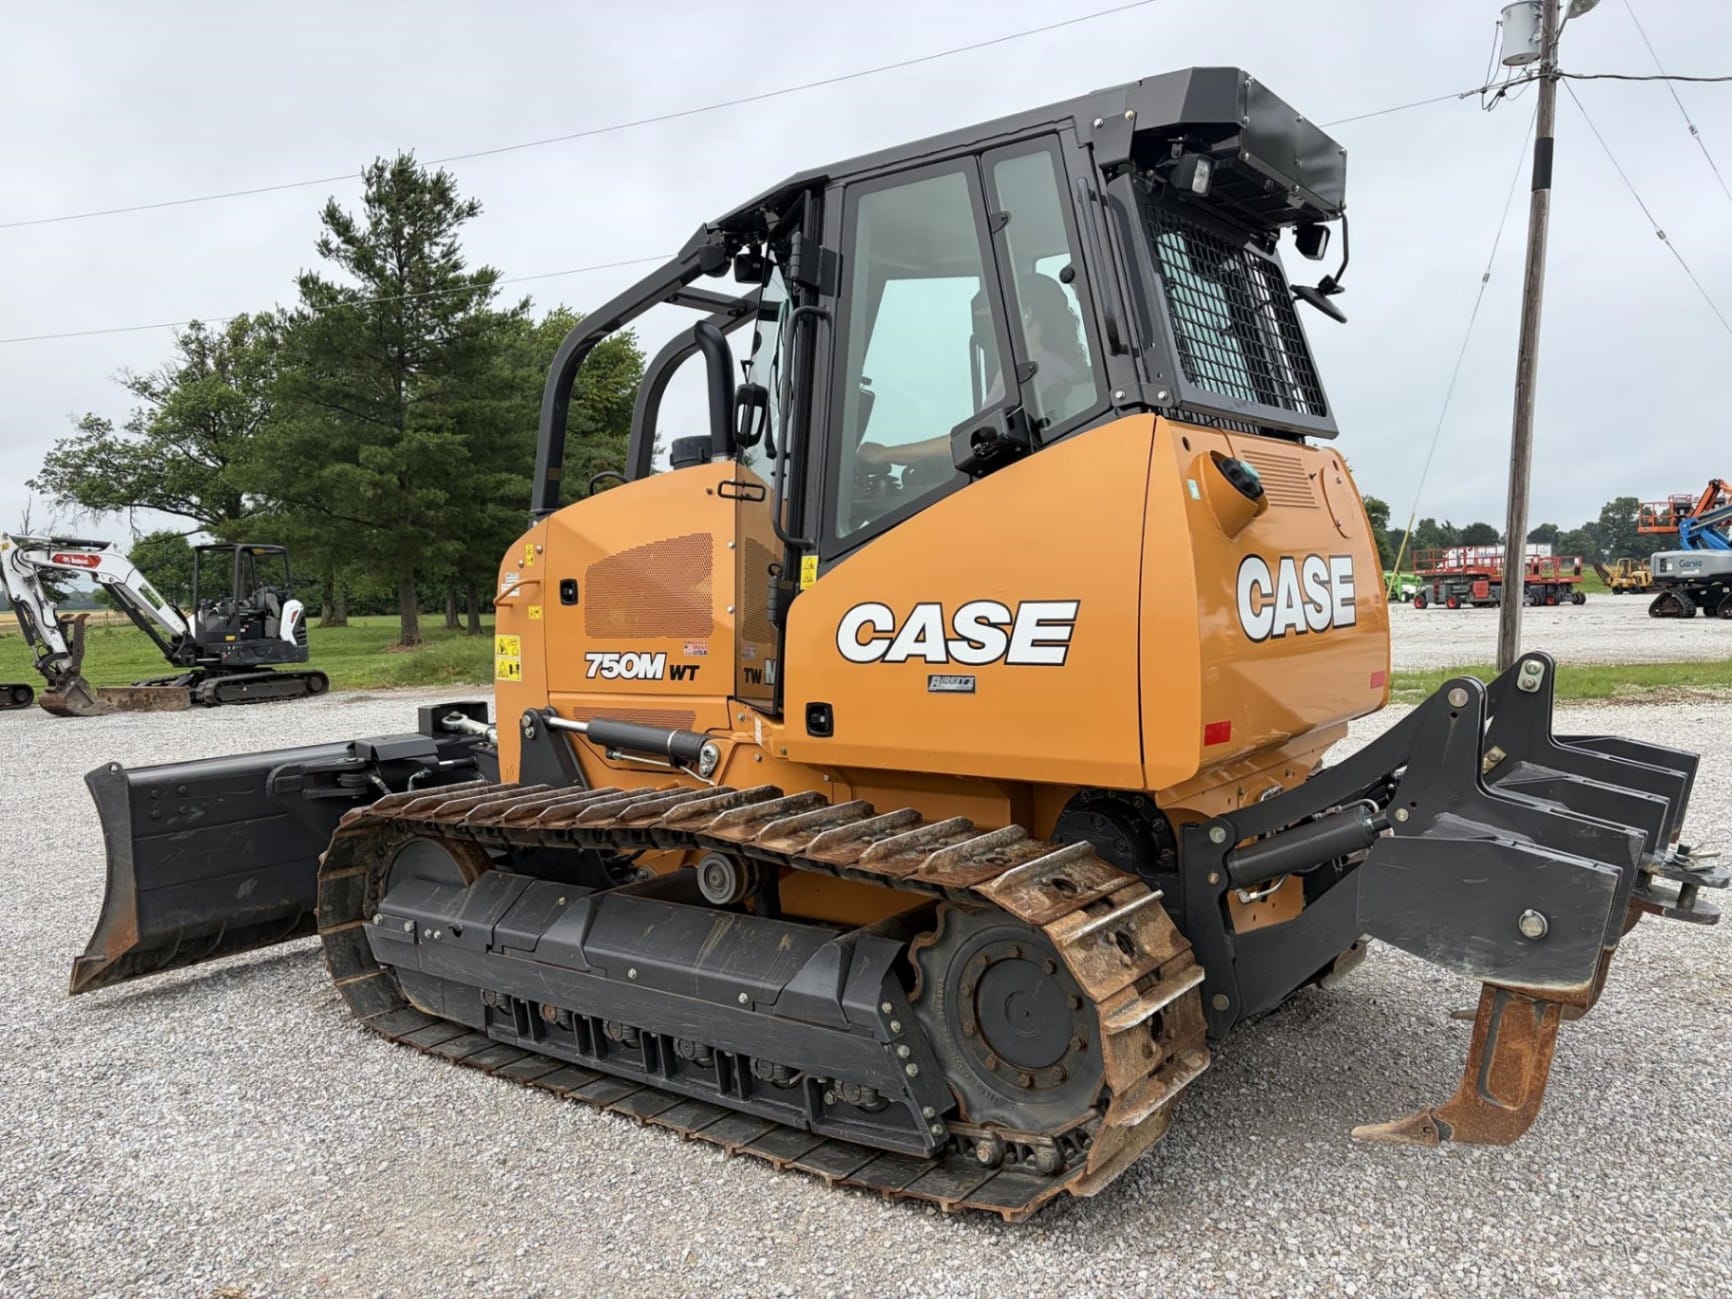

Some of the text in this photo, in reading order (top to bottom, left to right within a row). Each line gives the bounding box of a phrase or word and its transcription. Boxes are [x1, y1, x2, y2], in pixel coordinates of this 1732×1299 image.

[1679, 559, 1703, 568] Genie
[1236, 553, 1357, 643] CASE
[836, 599, 1081, 666] CASE
[585, 651, 700, 681] 750M WT
